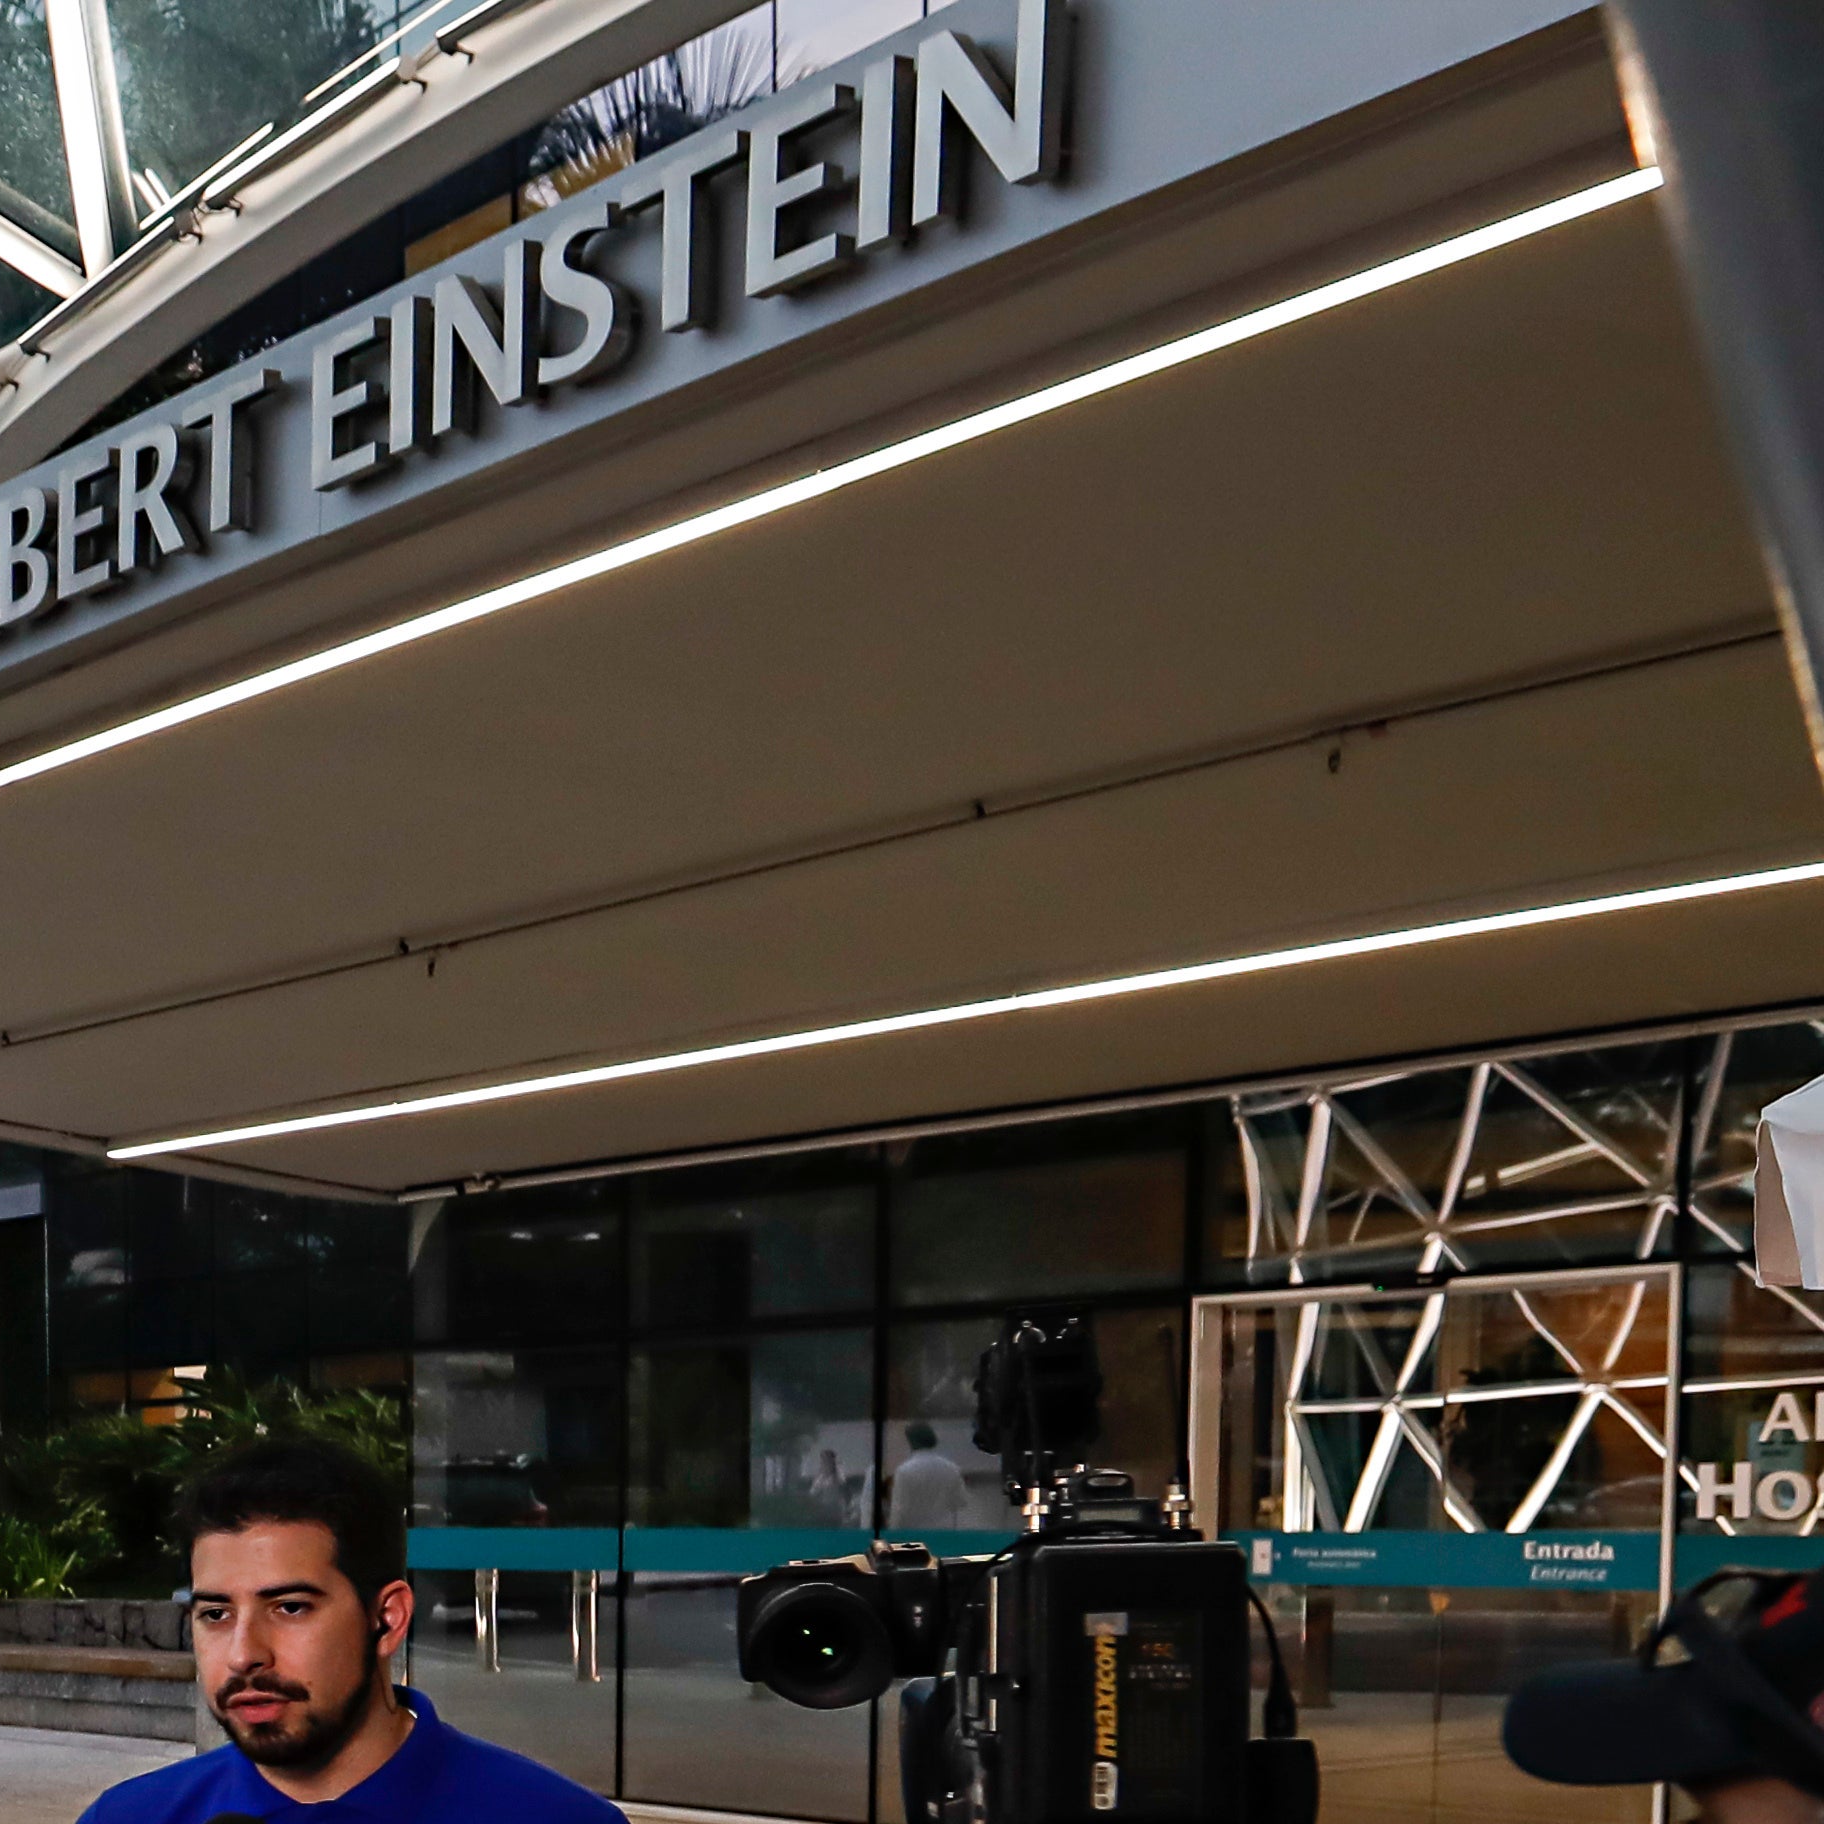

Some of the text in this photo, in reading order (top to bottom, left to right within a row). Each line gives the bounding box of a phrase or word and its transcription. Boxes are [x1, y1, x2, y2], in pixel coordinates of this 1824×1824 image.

[312, 0, 1062, 491] EINSTEIN
[1758, 1390, 1824, 1442] A
[1523, 1540, 1615, 1560] Entrada
[1531, 1563, 1608, 1581] Entrance
